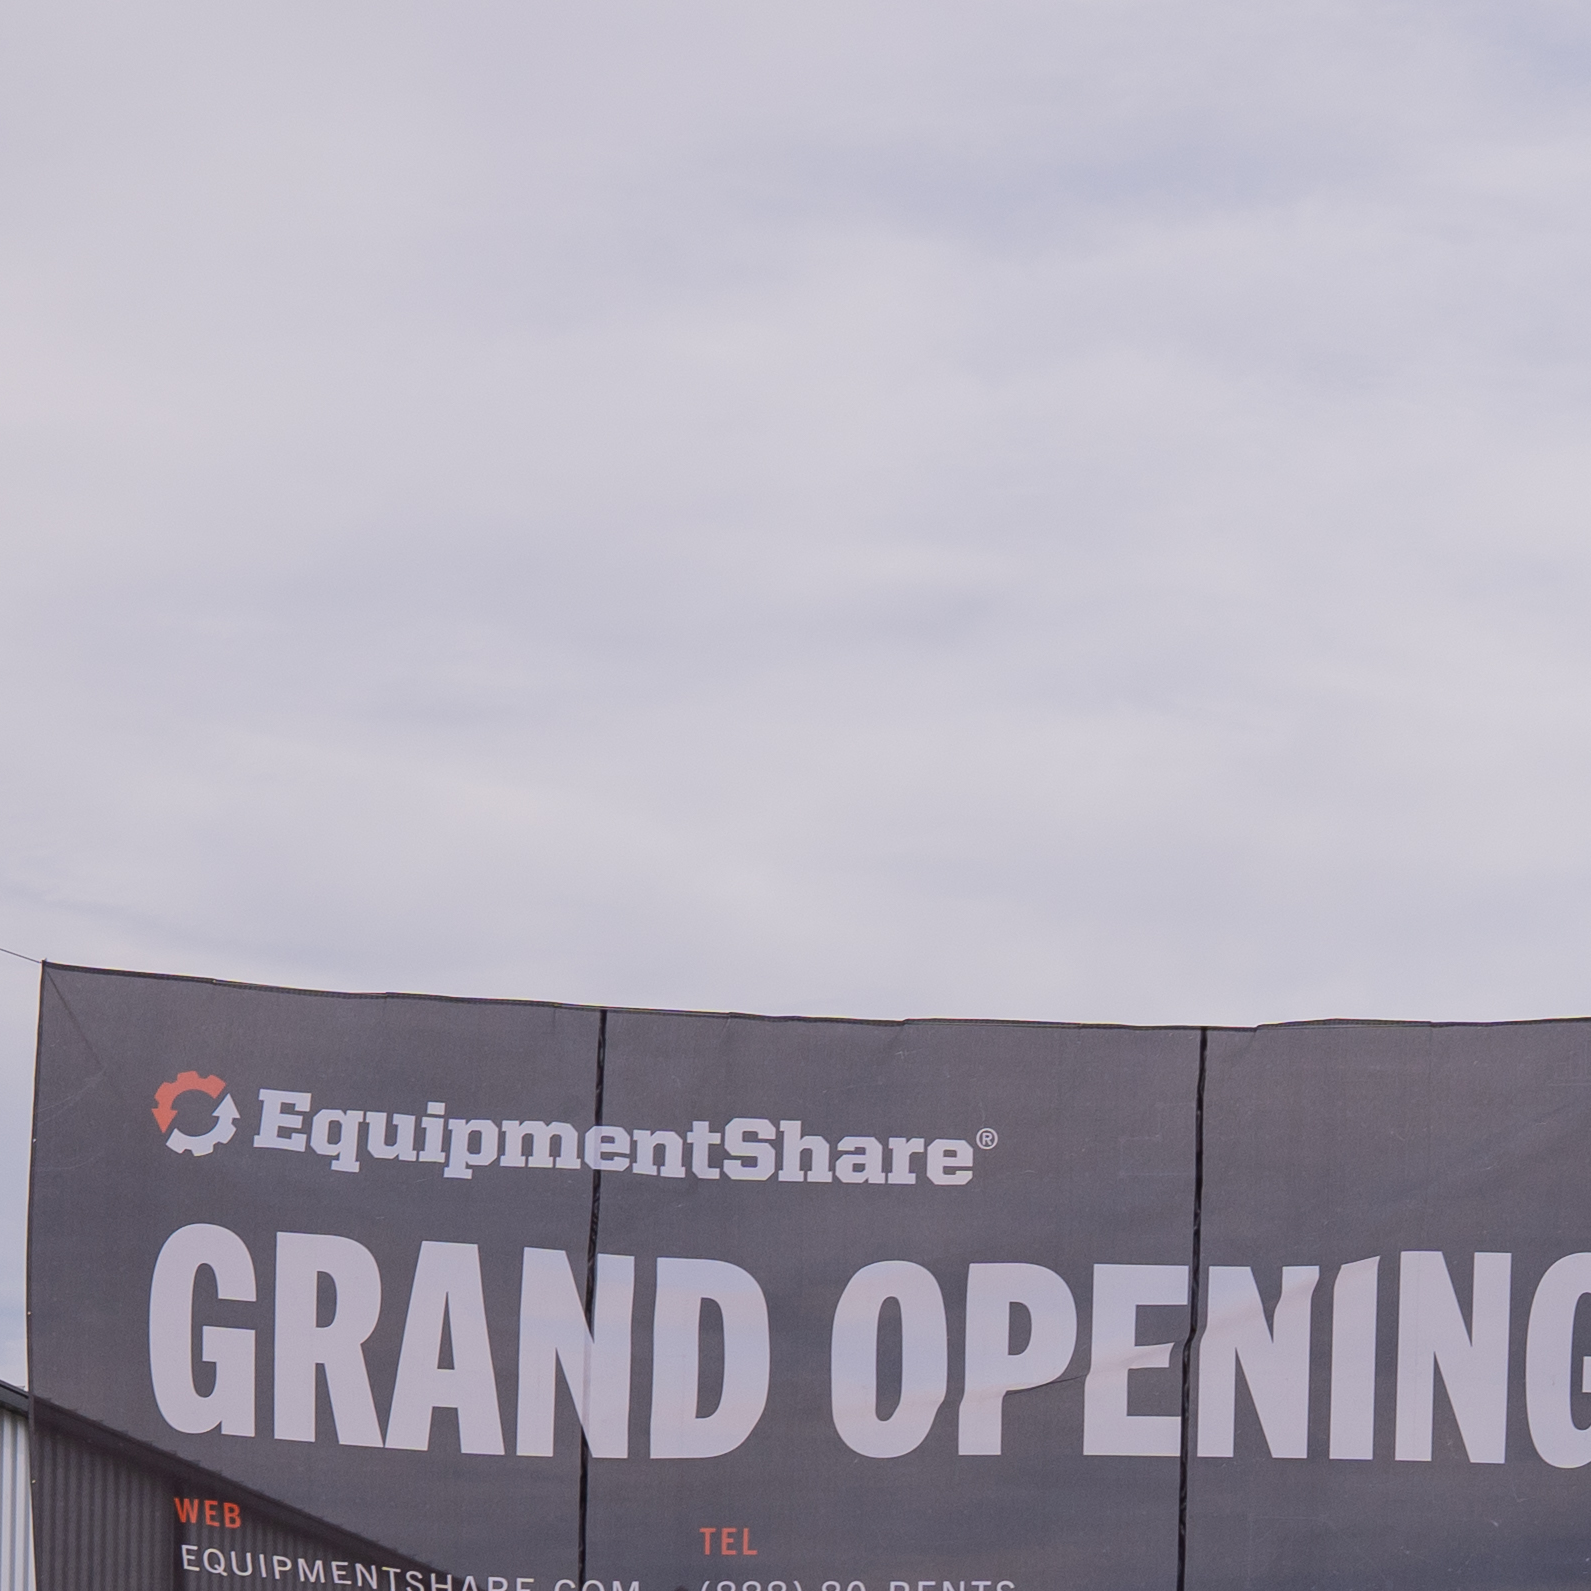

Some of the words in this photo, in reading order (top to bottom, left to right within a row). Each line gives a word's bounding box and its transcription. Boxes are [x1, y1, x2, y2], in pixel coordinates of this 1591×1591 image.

[149, 1223, 771, 1459] GRAND
[174, 1497, 242, 1529] WEB
[699, 1527, 758, 1556] TEL
